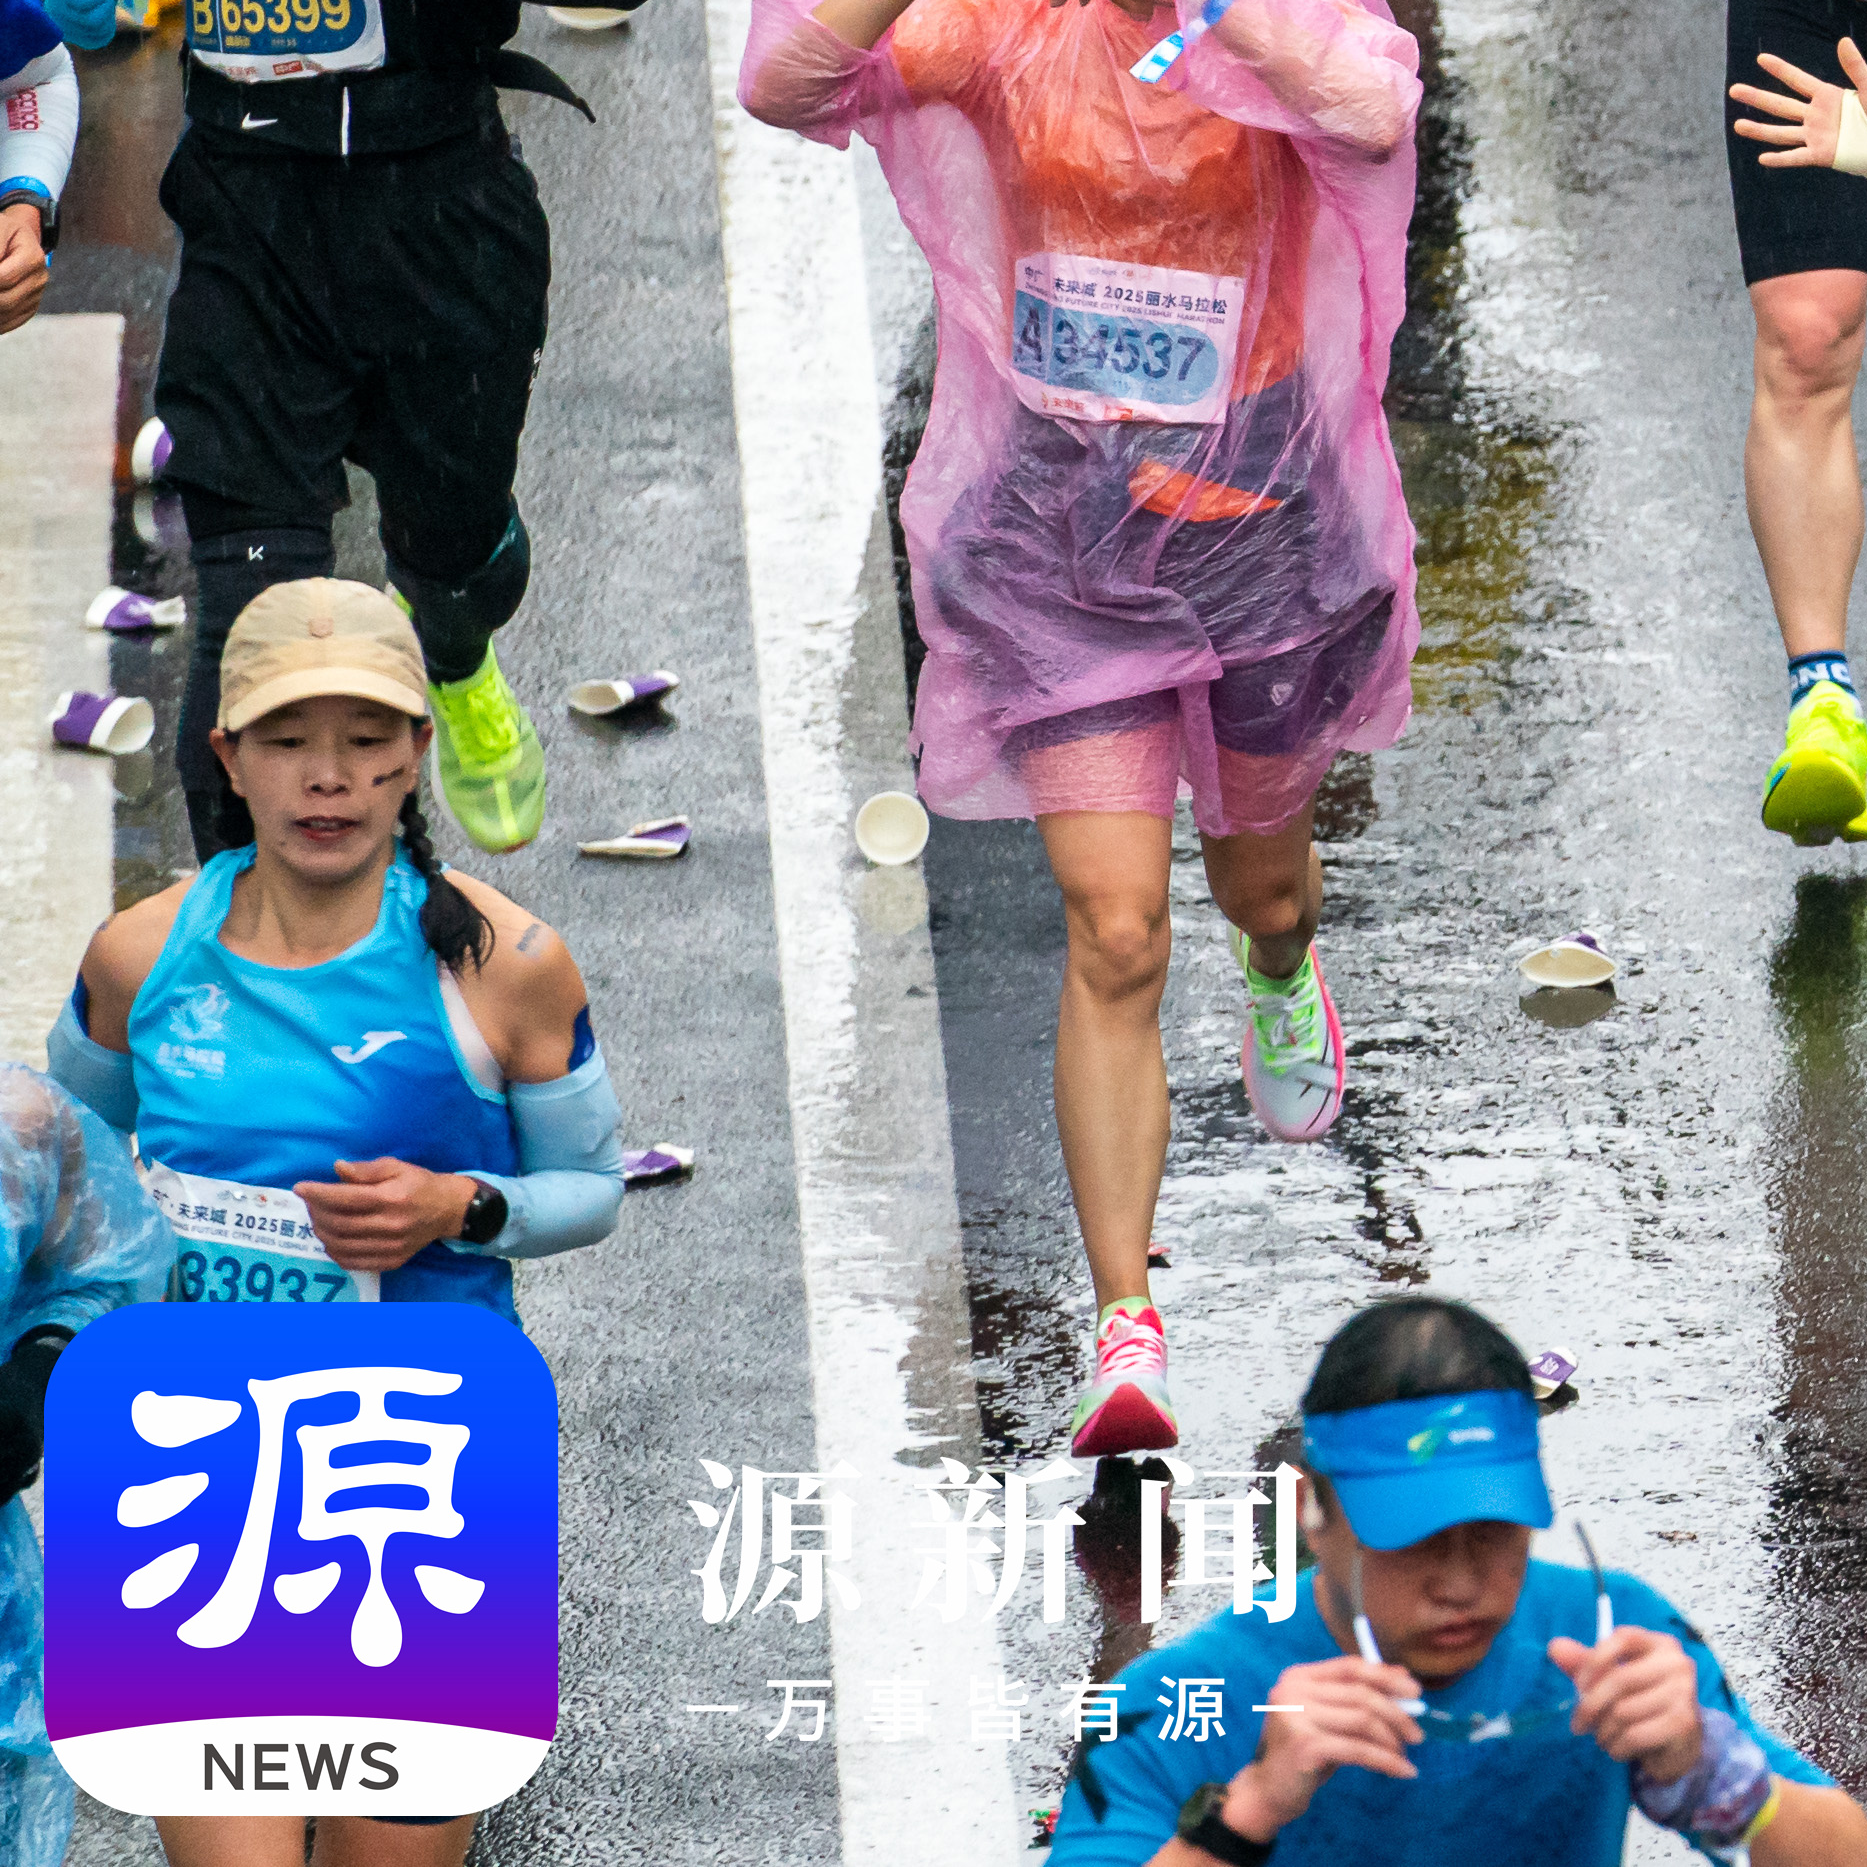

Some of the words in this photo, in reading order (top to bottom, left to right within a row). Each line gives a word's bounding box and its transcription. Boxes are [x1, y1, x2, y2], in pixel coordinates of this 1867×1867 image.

[1103, 286, 1228, 315] 2025丽水马拉松
[1053, 319, 1206, 381] 34537
